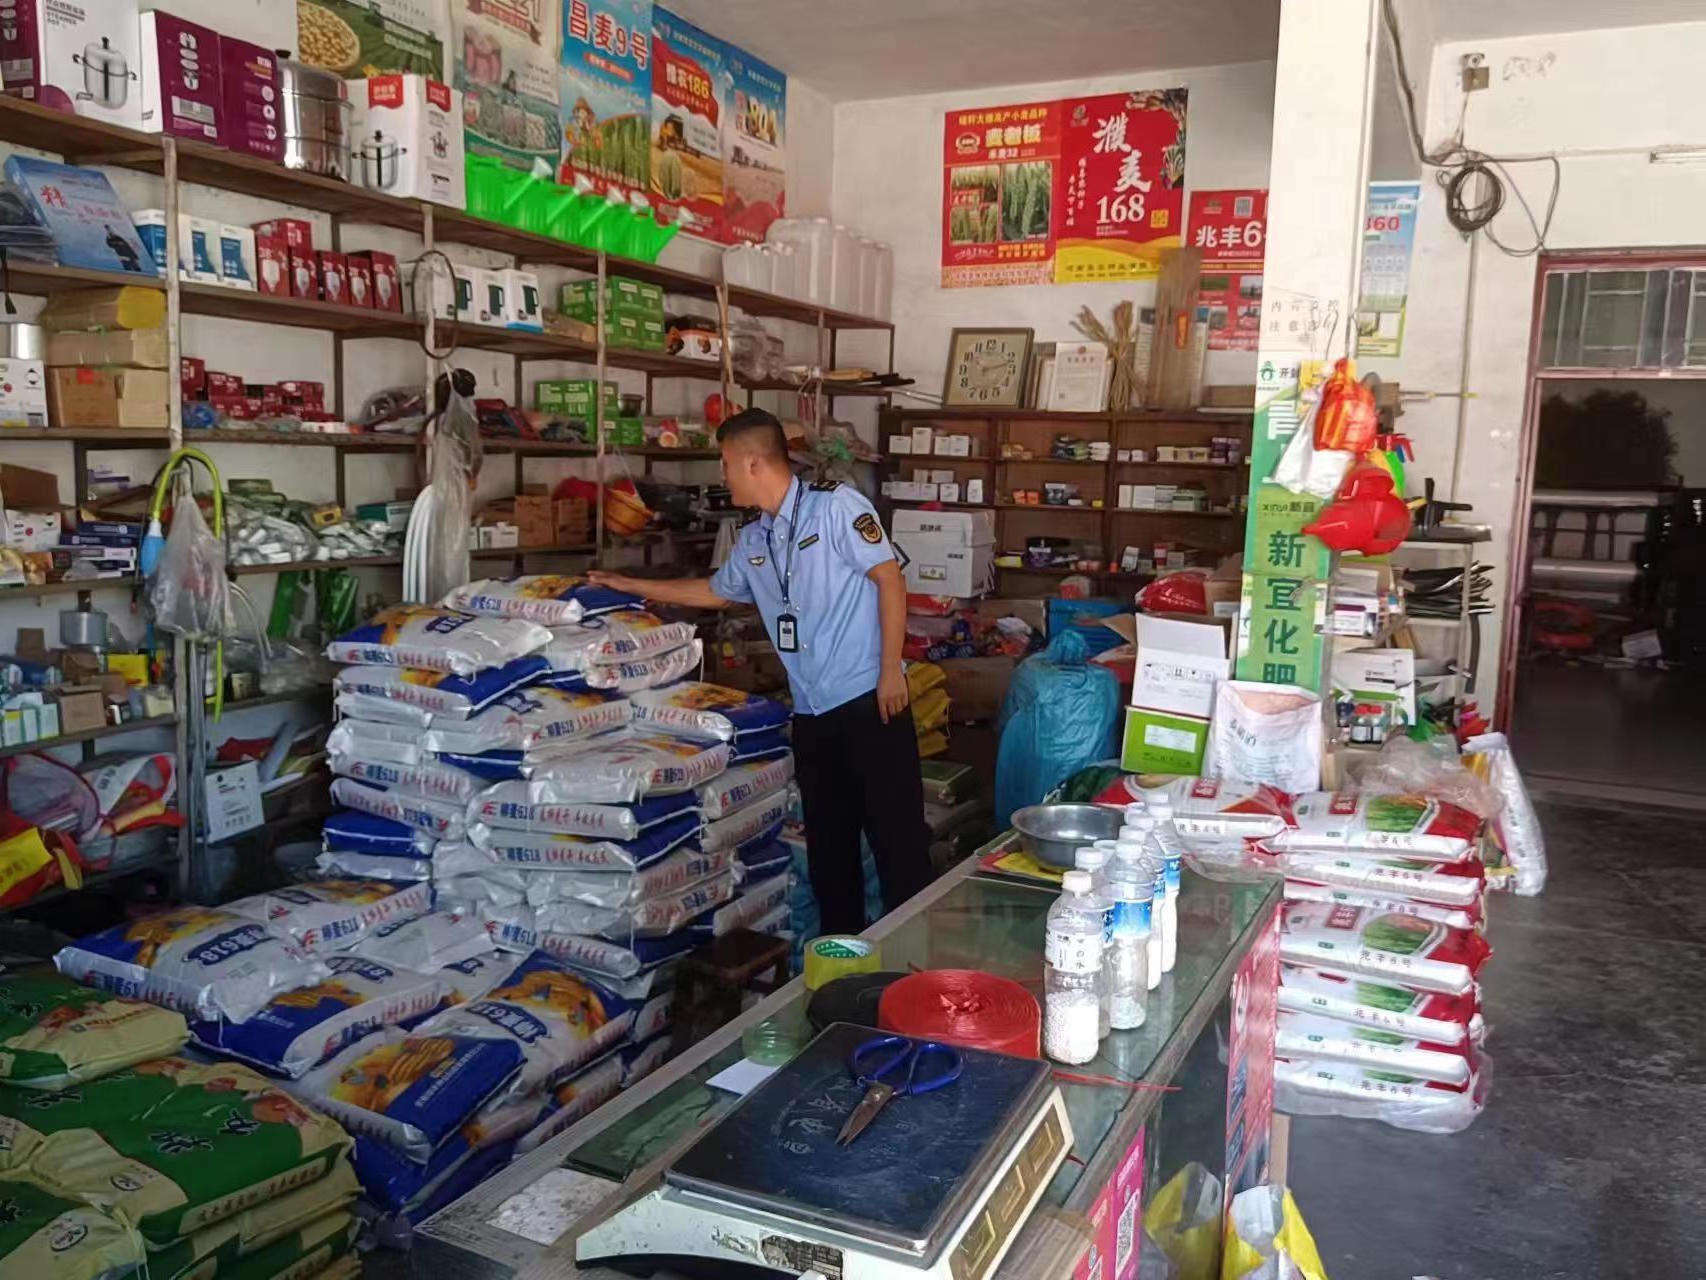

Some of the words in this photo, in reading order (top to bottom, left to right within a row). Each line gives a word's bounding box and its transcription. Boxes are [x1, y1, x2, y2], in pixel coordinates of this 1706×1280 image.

[1096, 193, 1145, 224] 168
[1195, 220, 1267, 248] 兆丰6
[1263, 530, 1306, 684] 新宜化肥
